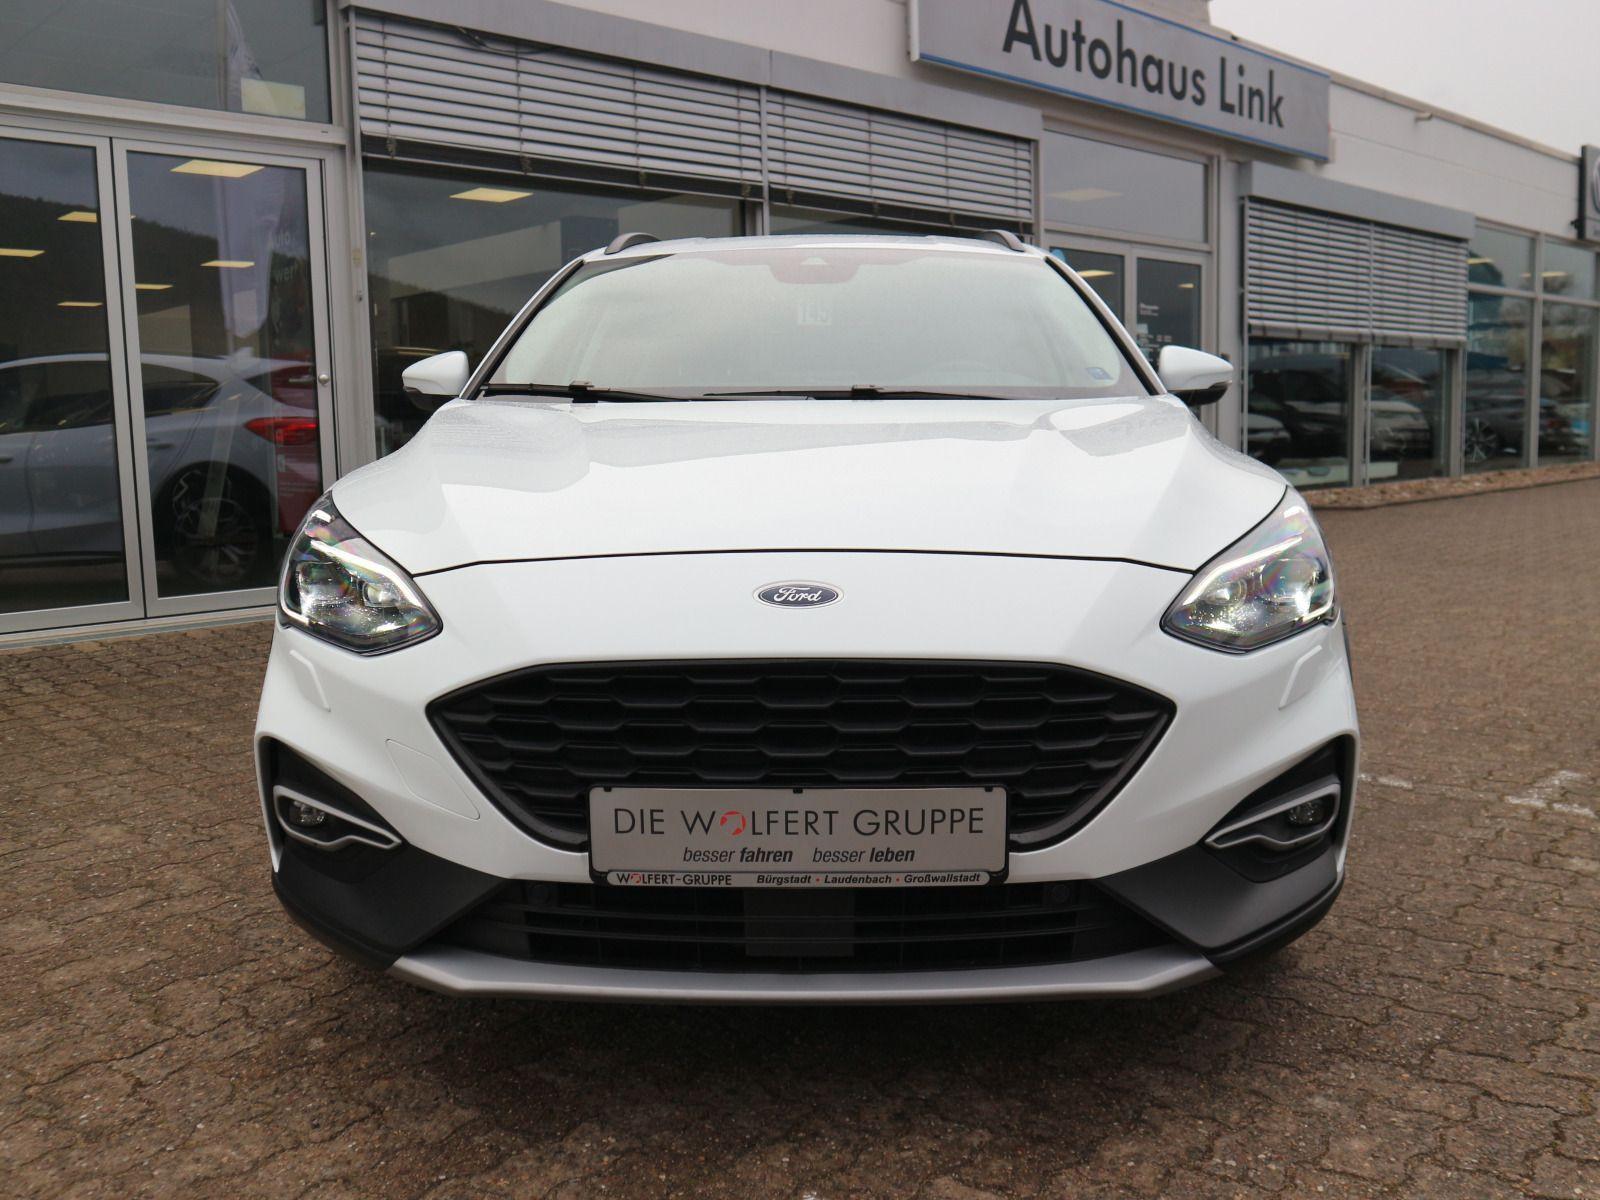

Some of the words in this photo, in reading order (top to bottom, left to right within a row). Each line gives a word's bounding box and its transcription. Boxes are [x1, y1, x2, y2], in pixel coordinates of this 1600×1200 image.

[1003, 0, 1206, 106] Autohaus
[1219, 57, 1285, 128] Link
[773, 587, 823, 602] Ford
[614, 808, 665, 835] DIE
[680, 810, 839, 836] WOLFERT
[853, 807, 984, 836] GRUPPE
[683, 847, 736, 863] besser
[739, 847, 793, 863] fahren
[812, 847, 866, 863] besser
[869, 847, 916, 863] leben
[616, 872, 732, 886] WOLFERT-GRUPPE
[756, 874, 812, 886] Bürgstadt
[823, 874, 893, 885] Laudenbach
[903, 873, 981, 884] Großwallstadt
